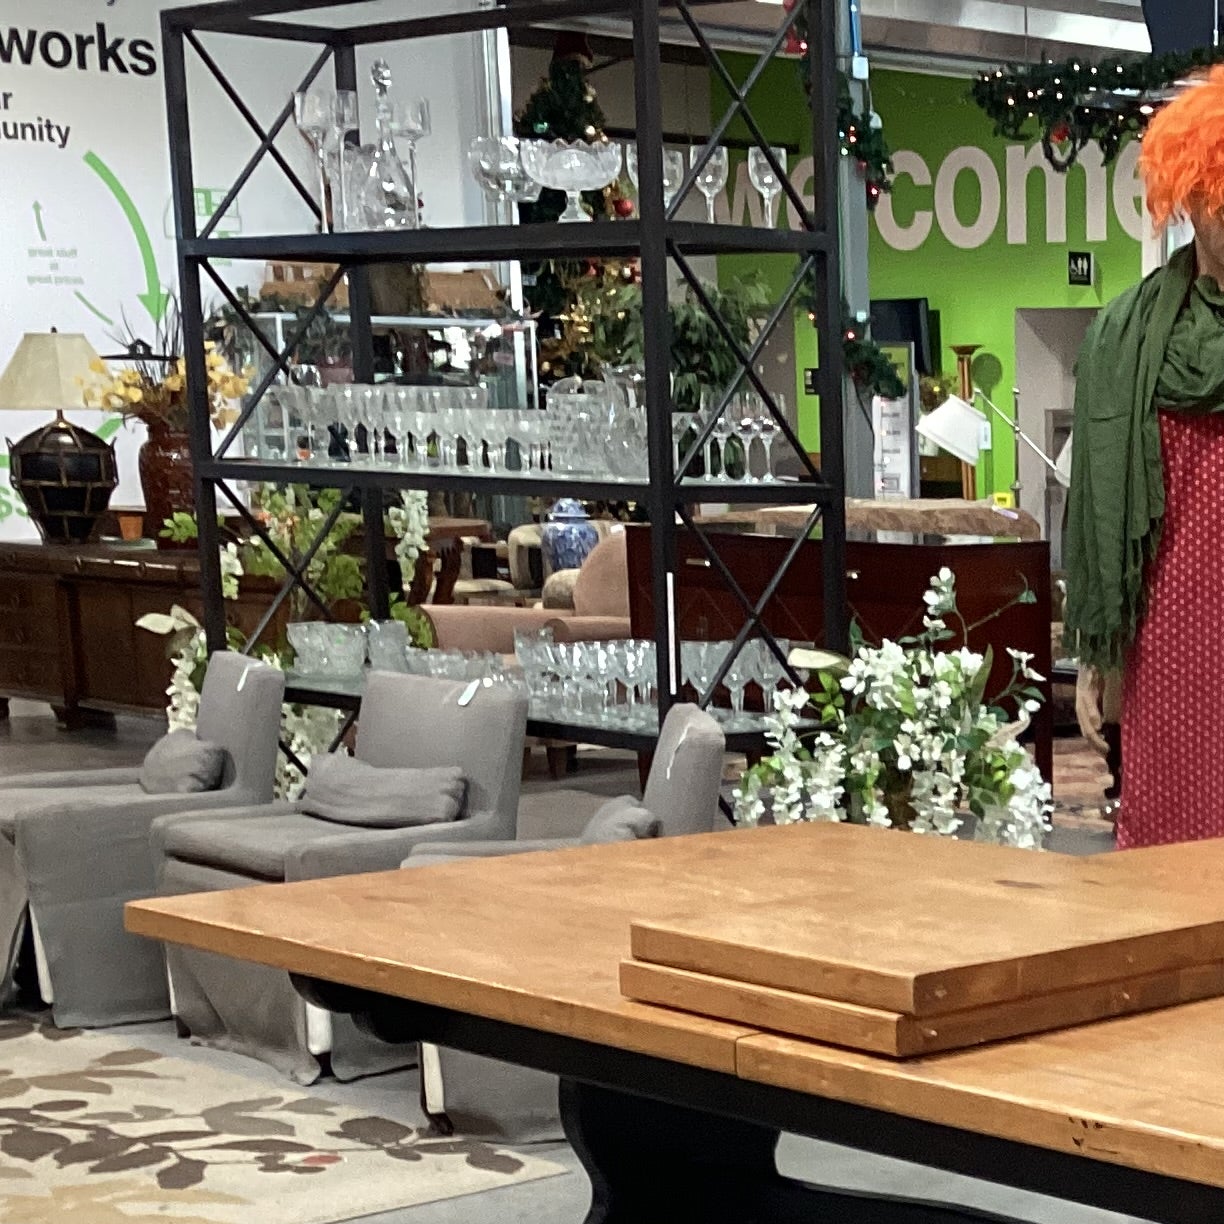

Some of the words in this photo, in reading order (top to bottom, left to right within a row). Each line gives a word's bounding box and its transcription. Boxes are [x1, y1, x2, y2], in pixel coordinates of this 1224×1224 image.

[0, 22, 157, 76] works
[0, 92, 13, 110] r
[0, 116, 70, 148] unity
